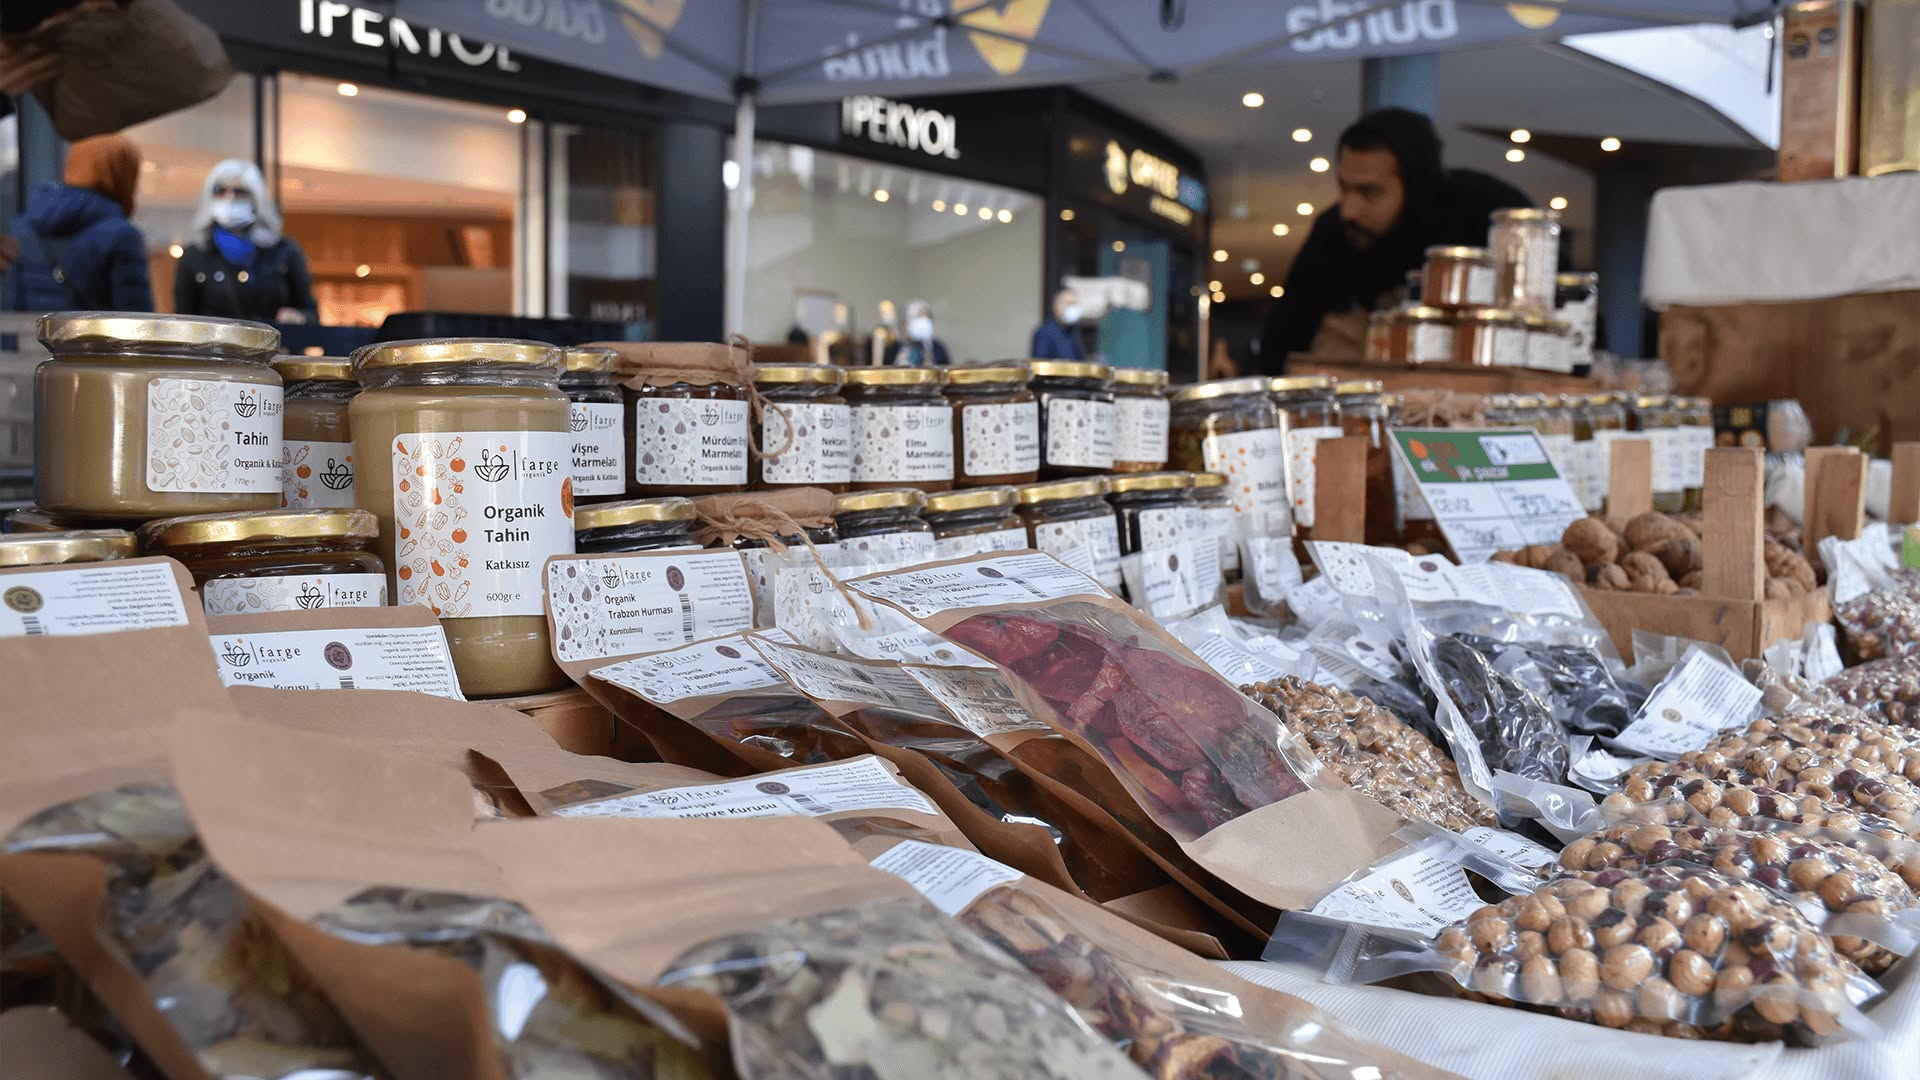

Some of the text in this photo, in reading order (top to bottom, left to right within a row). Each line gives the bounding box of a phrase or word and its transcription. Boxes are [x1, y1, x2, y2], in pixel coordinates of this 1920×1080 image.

[594, 414, 617, 427] farge
[235, 431, 269, 446] Tahin
[701, 436, 738, 446] Mürdüm
[905, 439, 927, 448] Elma
[571, 443, 599, 456] Vişne
[234, 458, 265, 470] Organik
[266, 459, 272, 469] &
[521, 457, 559, 474] farge
[701, 464, 724, 472] Organik
[484, 504, 545, 523] Organik
[484, 528, 530, 543] Tahin
[485, 559, 530, 571] Katkısız
[624, 570, 652, 580] farge
[334, 588, 368, 602] farge
[486, 592, 513, 604] 600gr
[604, 593, 636, 606] Organik
[608, 606, 673, 620] Trabzon Hurması
[609, 627, 644, 637] Kurutulmuş
[259, 645, 301, 658] farge
[233, 670, 276, 682] Organik
[683, 665, 748, 682] Trabzon Hurması
[686, 787, 733, 799] farge
[679, 802, 777, 819] Meyve Kurusu
